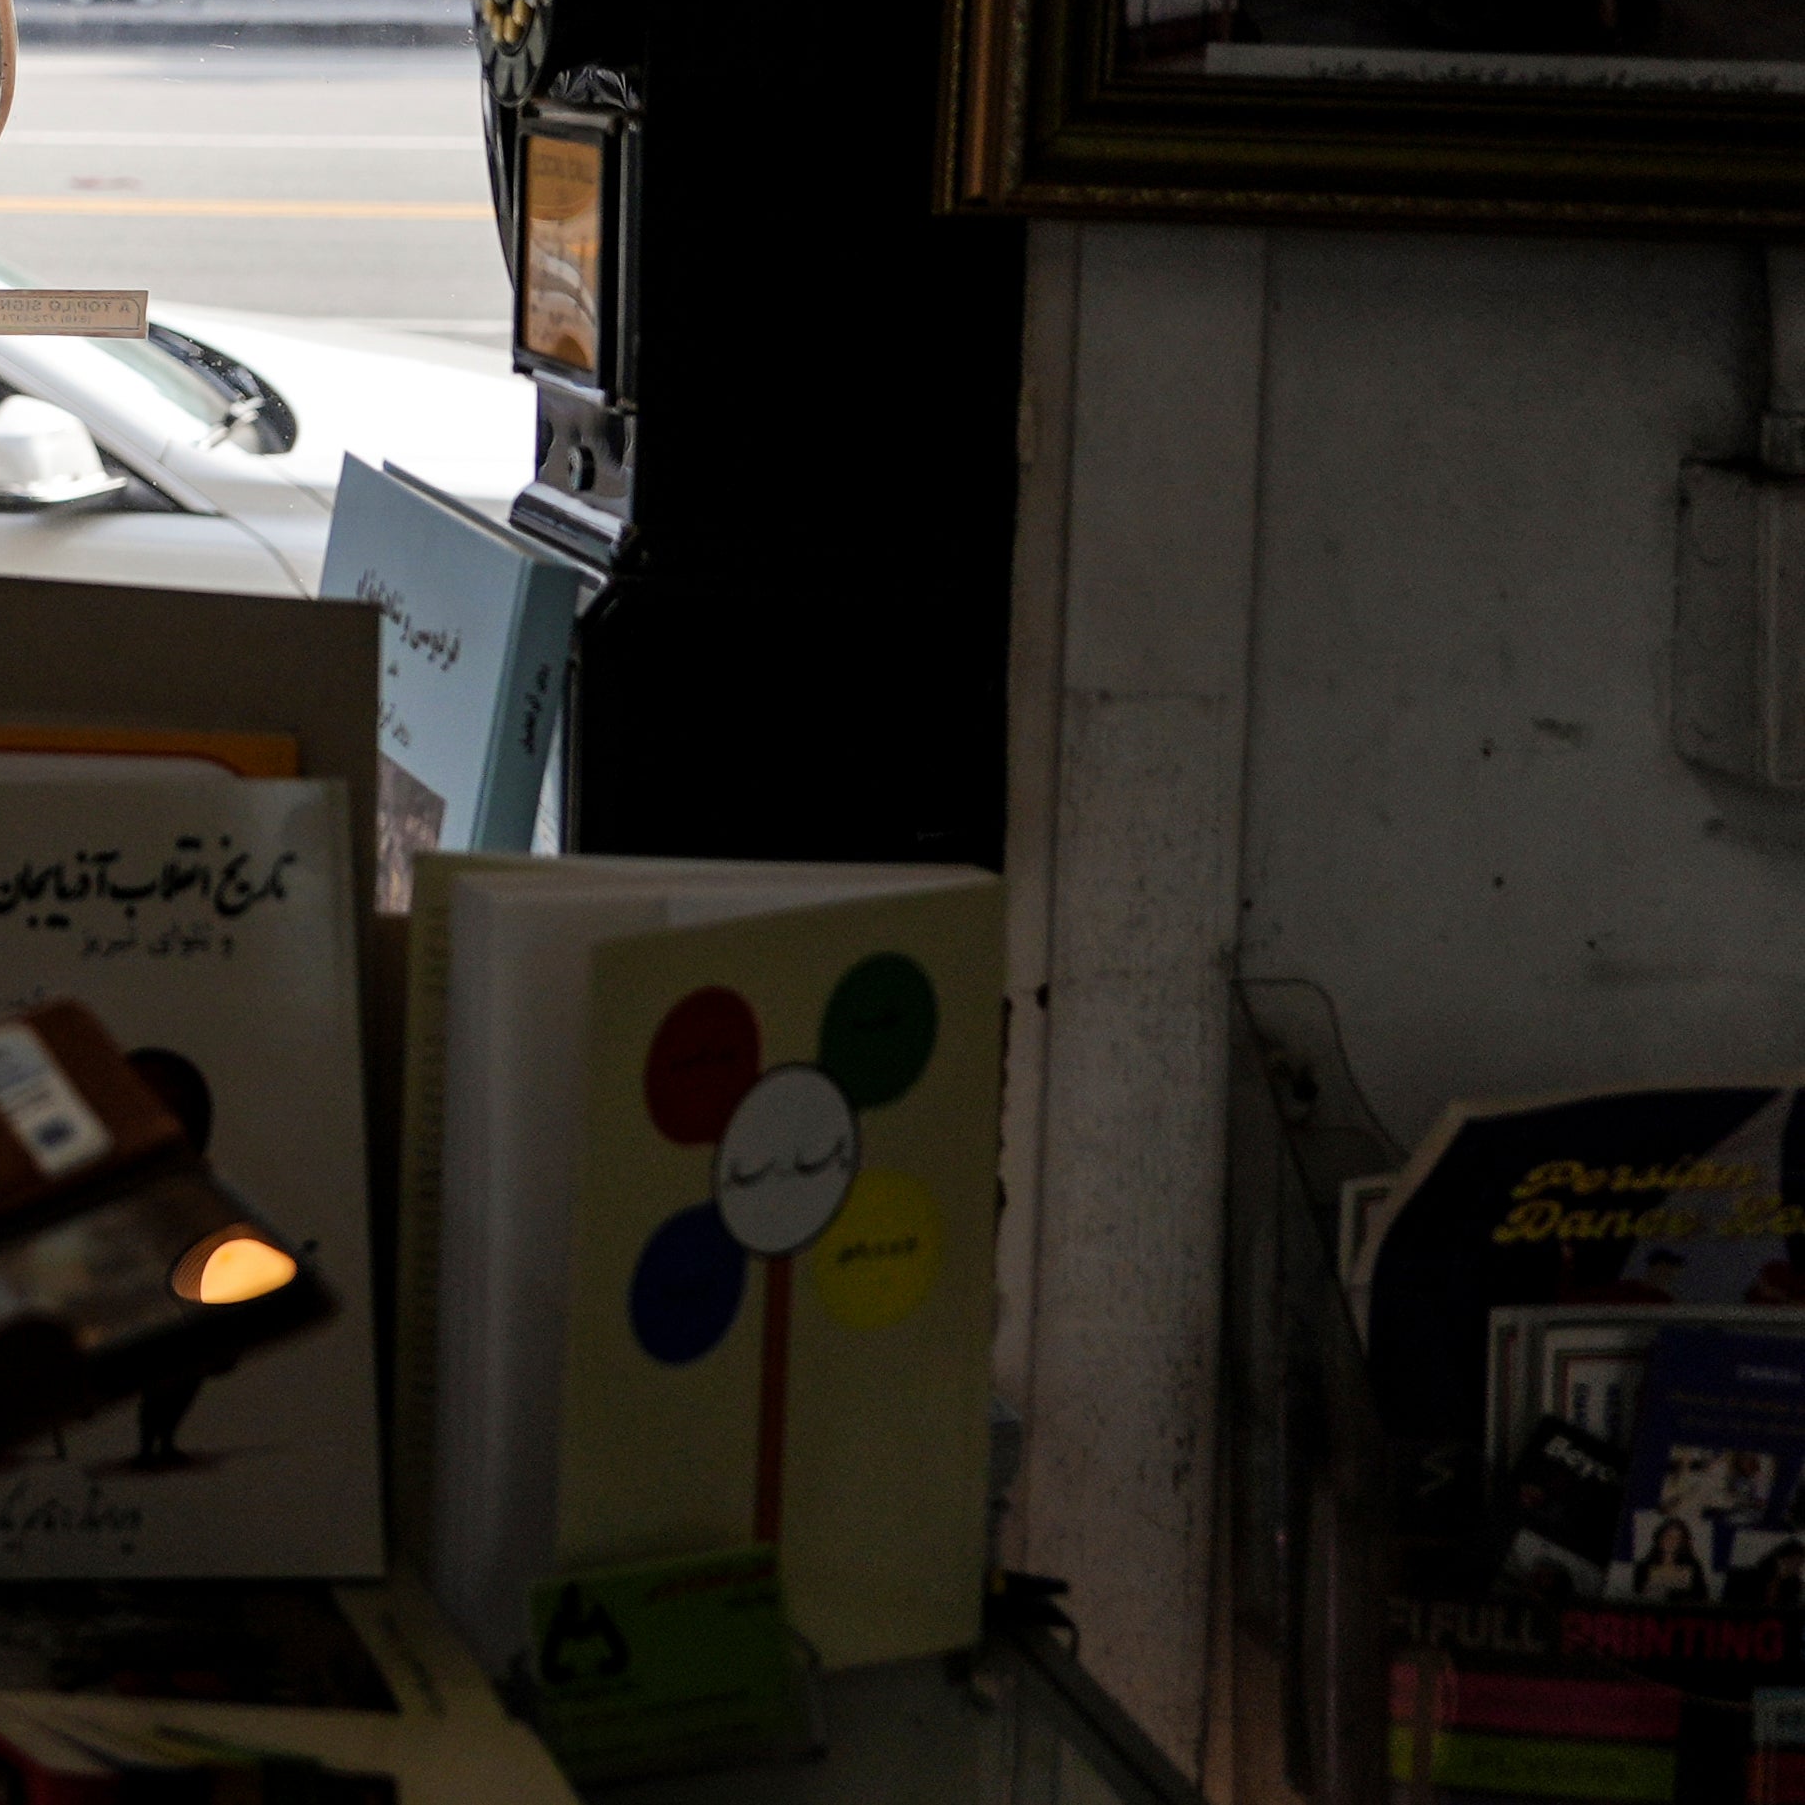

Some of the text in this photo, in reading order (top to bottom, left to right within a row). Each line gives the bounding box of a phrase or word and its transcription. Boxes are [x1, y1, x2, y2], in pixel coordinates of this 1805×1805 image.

[111, 834, 210, 918] انقلاب
[1509, 1158, 1761, 1199] Persian
[1492, 1199, 1699, 1244] Dance
